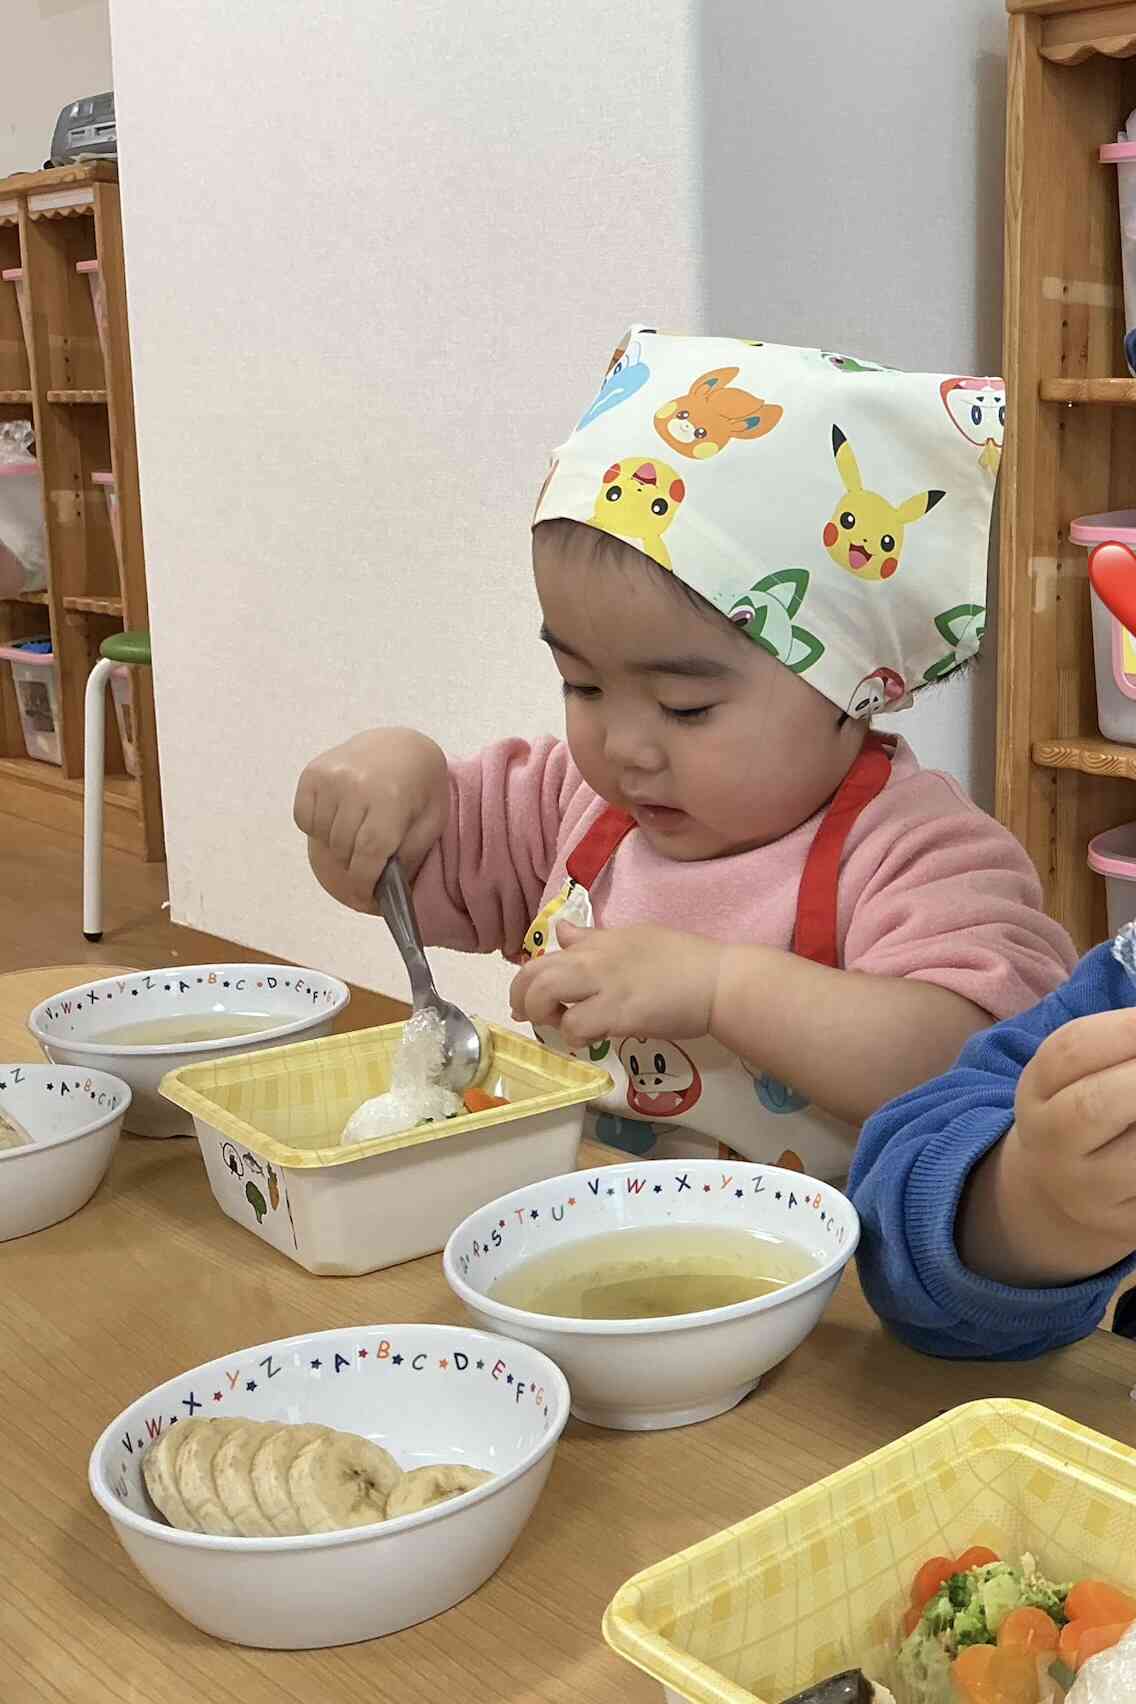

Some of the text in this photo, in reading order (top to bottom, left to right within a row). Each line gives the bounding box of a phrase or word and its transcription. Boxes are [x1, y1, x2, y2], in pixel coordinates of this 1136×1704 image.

[61, 1001, 72, 1014] W
[86, 990, 99, 1004] X
[116, 980, 126, 993] Y
[142, 976, 156, 989] Z
[179, 981, 190, 993] A
[208, 972, 217, 984] B
[236, 980, 246, 990] C
[267, 977, 277, 988] D
[295, 980, 305, 992] E
[10, 1068, 25, 1083] Z
[61, 1081, 70, 1096] A
[84, 1078, 92, 1092] B
[98, 1092, 106, 1104] C
[472, 1174, 835, 1257] R S T U V W X Y Z A B C
[122, 1432, 133, 1454] V
[145, 1416, 162, 1440] W
[182, 1391, 202, 1416] X
[226, 1370, 240, 1390] Y
[259, 1356, 282, 1378] Z
[335, 1353, 350, 1373] A
[376, 1340, 391, 1359] B
[412, 1353, 427, 1370] C
[454, 1352, 469, 1370] D
[491, 1359, 506, 1380] E
[516, 1382, 525, 1403] F
